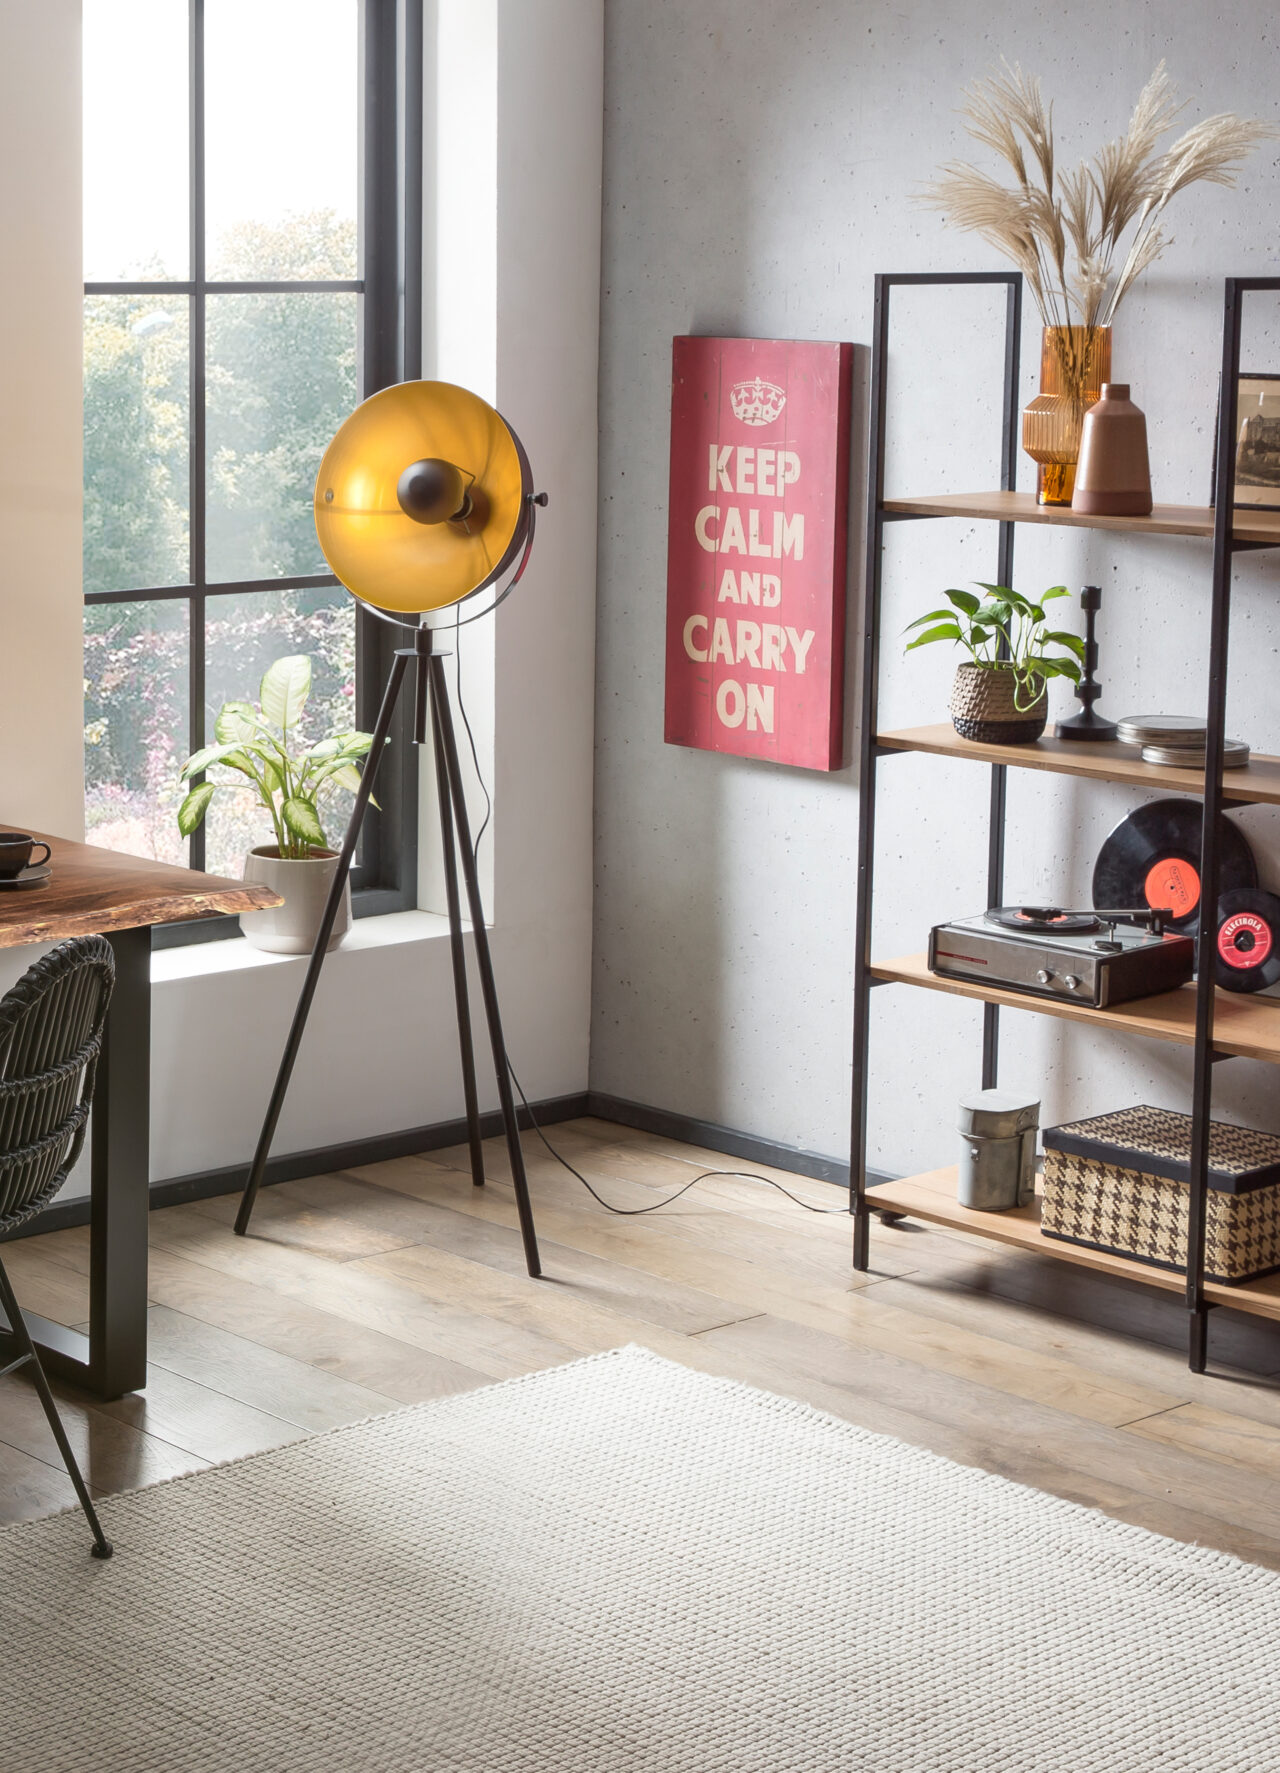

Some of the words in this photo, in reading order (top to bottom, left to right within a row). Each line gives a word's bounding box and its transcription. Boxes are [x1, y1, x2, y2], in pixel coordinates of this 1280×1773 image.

[708, 443, 801, 497] KEEP
[694, 504, 805, 561] CALM
[717, 569, 782, 609] AND
[683, 614, 815, 675] CARRY
[716, 678, 775, 734] ON
[1224, 917, 1262, 936] ELECTROLA
